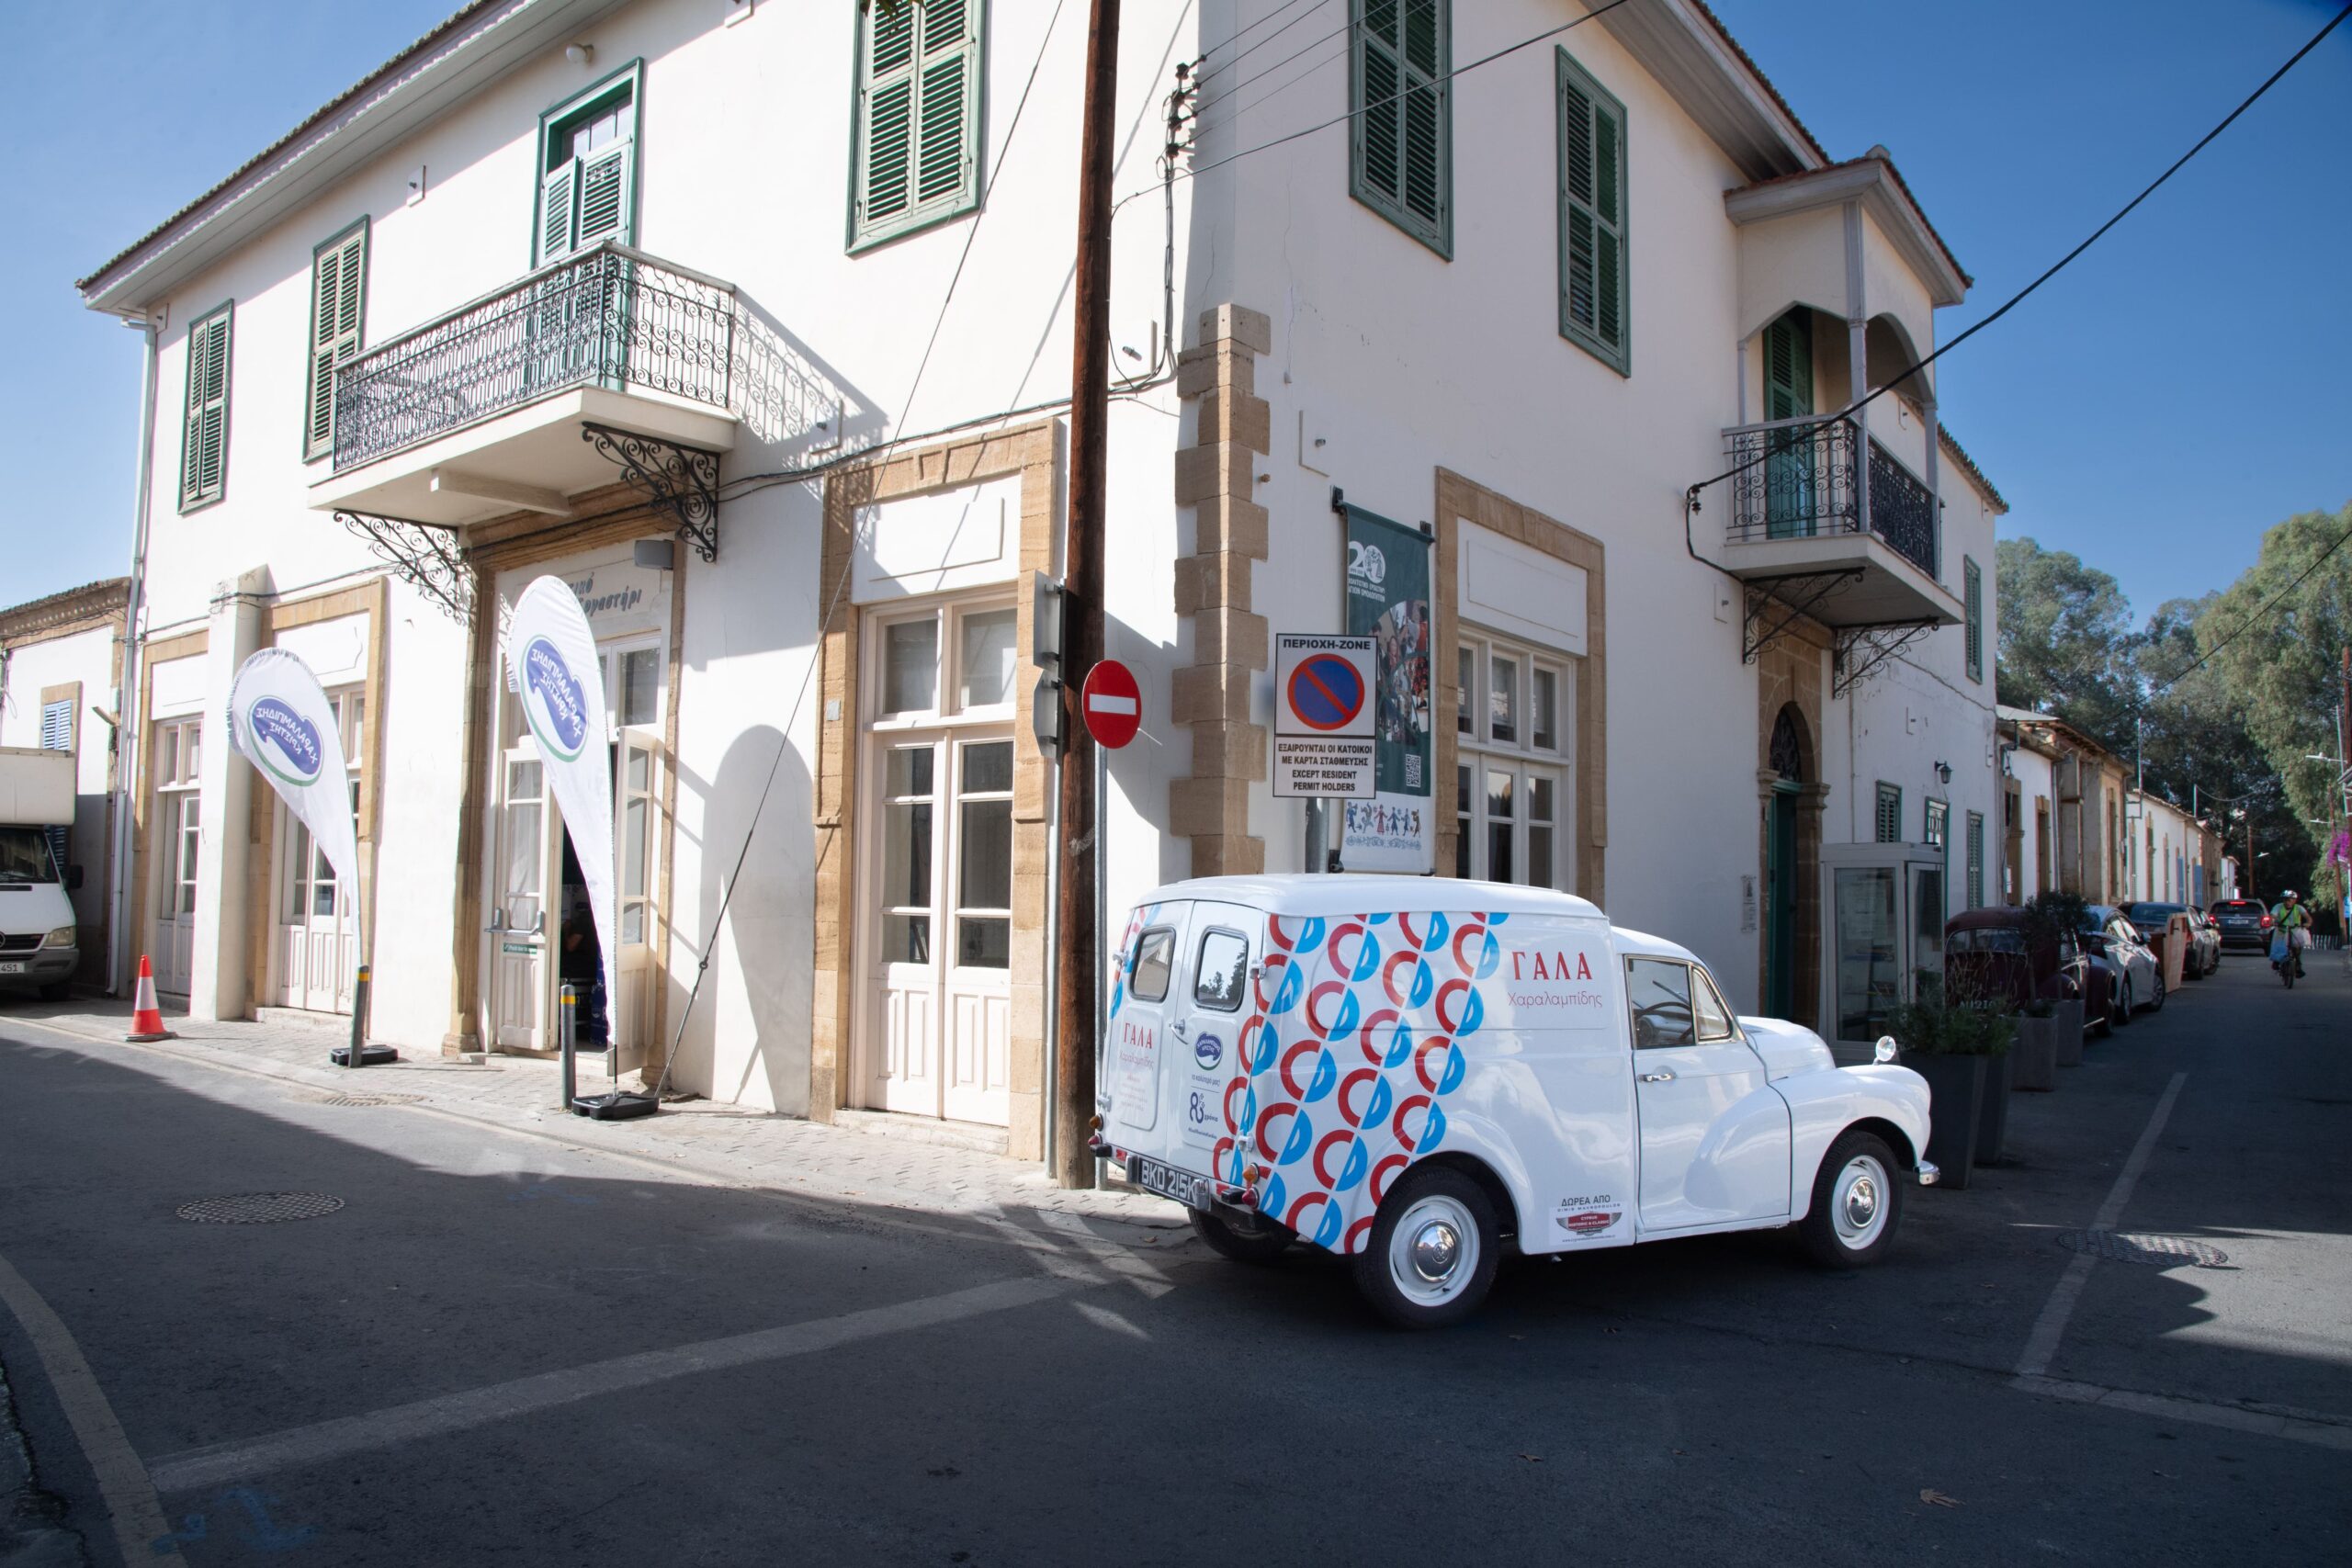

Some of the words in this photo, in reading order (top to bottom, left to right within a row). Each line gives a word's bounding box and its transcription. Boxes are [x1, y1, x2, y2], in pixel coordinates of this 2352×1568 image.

[579, 585, 642, 617] ργαστήρι
[1278, 743, 1326, 753] ΕΞΑΙΡΟΥΝΤΑΙ
[1328, 744, 1336, 753] ΟΙ
[1338, 745, 1372, 754] ΚΑΤΟΙΚΟΙ
[1282, 756, 1292, 764] ΜΕ
[1295, 756, 1318, 765] ΚΑΡΤΑ
[1319, 757, 1368, 766] ΣΤΑΘΜΕΥΣΗΣ
[1292, 770, 1319, 778] EXCEPT
[1322, 771, 1357, 780] RESIDENT
[1293, 782, 1320, 791] PERMIT
[1322, 783, 1355, 792] HOLDERS
[1511, 951, 1592, 980] ΓΑΛΑ
[1508, 990, 1602, 1009] Χαραλαμπίδης
[1124, 1022, 1152, 1049] ΓΑΛΑ
[1141, 1160, 1165, 1190] BKD
[1167, 1170, 1195, 1203] 215K
[1562, 1197, 1590, 1207] ΔΩΡΕΑ
